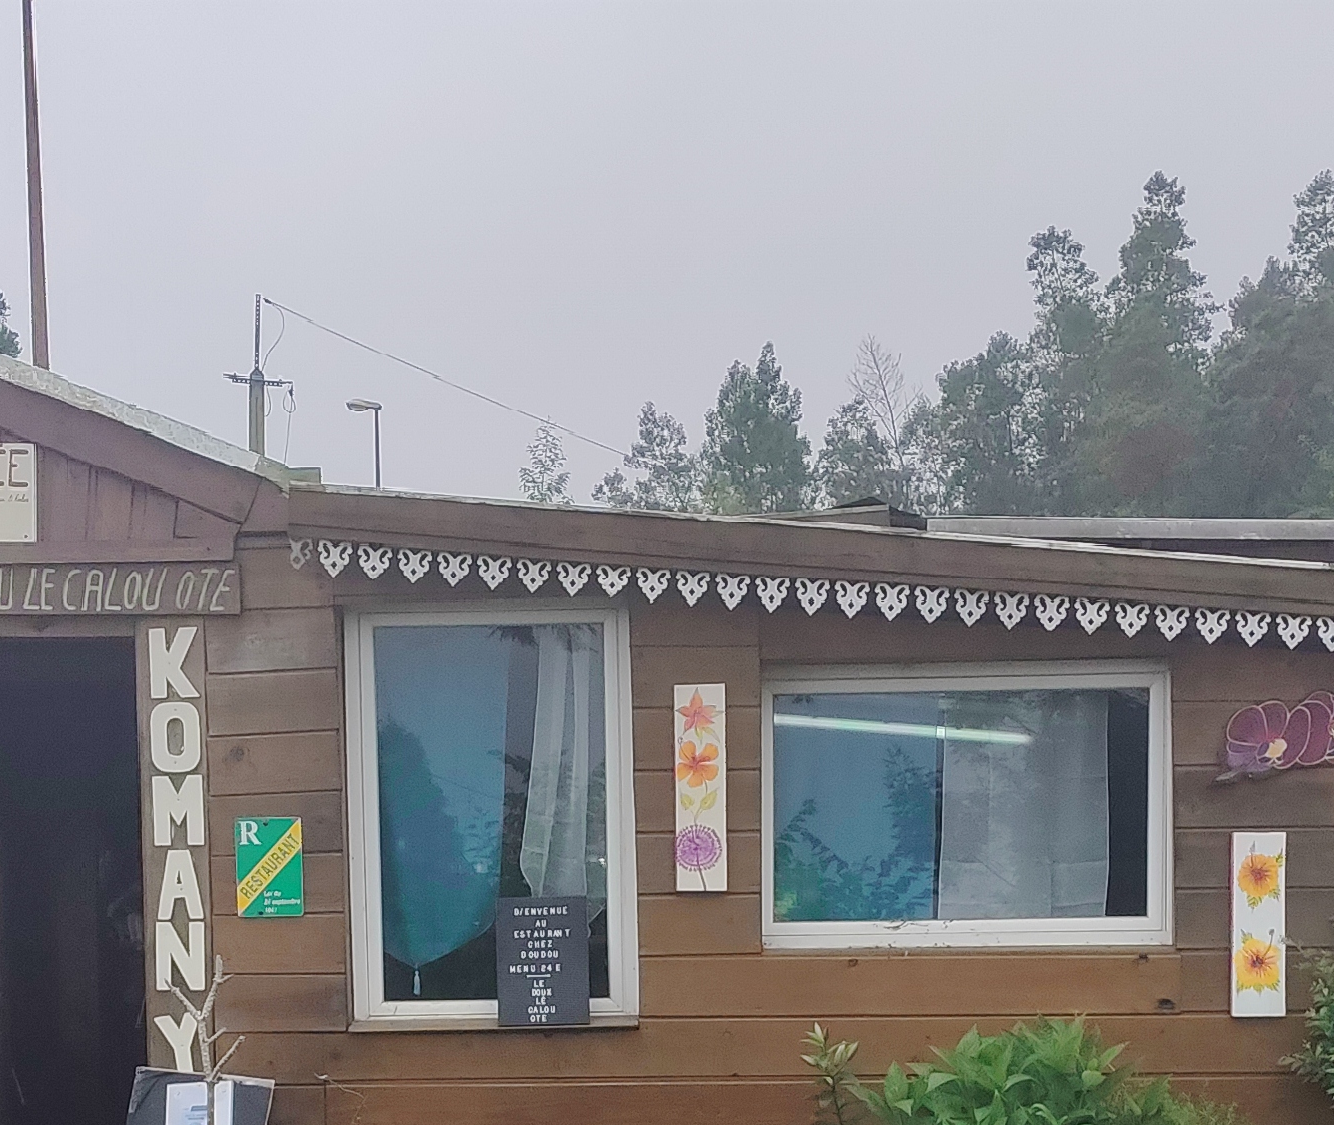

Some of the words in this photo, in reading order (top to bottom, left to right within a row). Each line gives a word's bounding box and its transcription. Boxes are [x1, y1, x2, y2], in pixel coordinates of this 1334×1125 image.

[175, 568, 236, 612] OTE
[238, 820, 262, 846] R
[148, 626, 206, 1073] KOMANY
[239, 833, 299, 900] RESTAURANT
[535, 919, 547, 928] AU
[527, 939, 553, 949] CHEZ
[509, 964, 536, 974] MENU
[533, 979, 545, 988] LE
[531, 988, 552, 997] DOUX
[527, 1005, 556, 1014] CALOU
